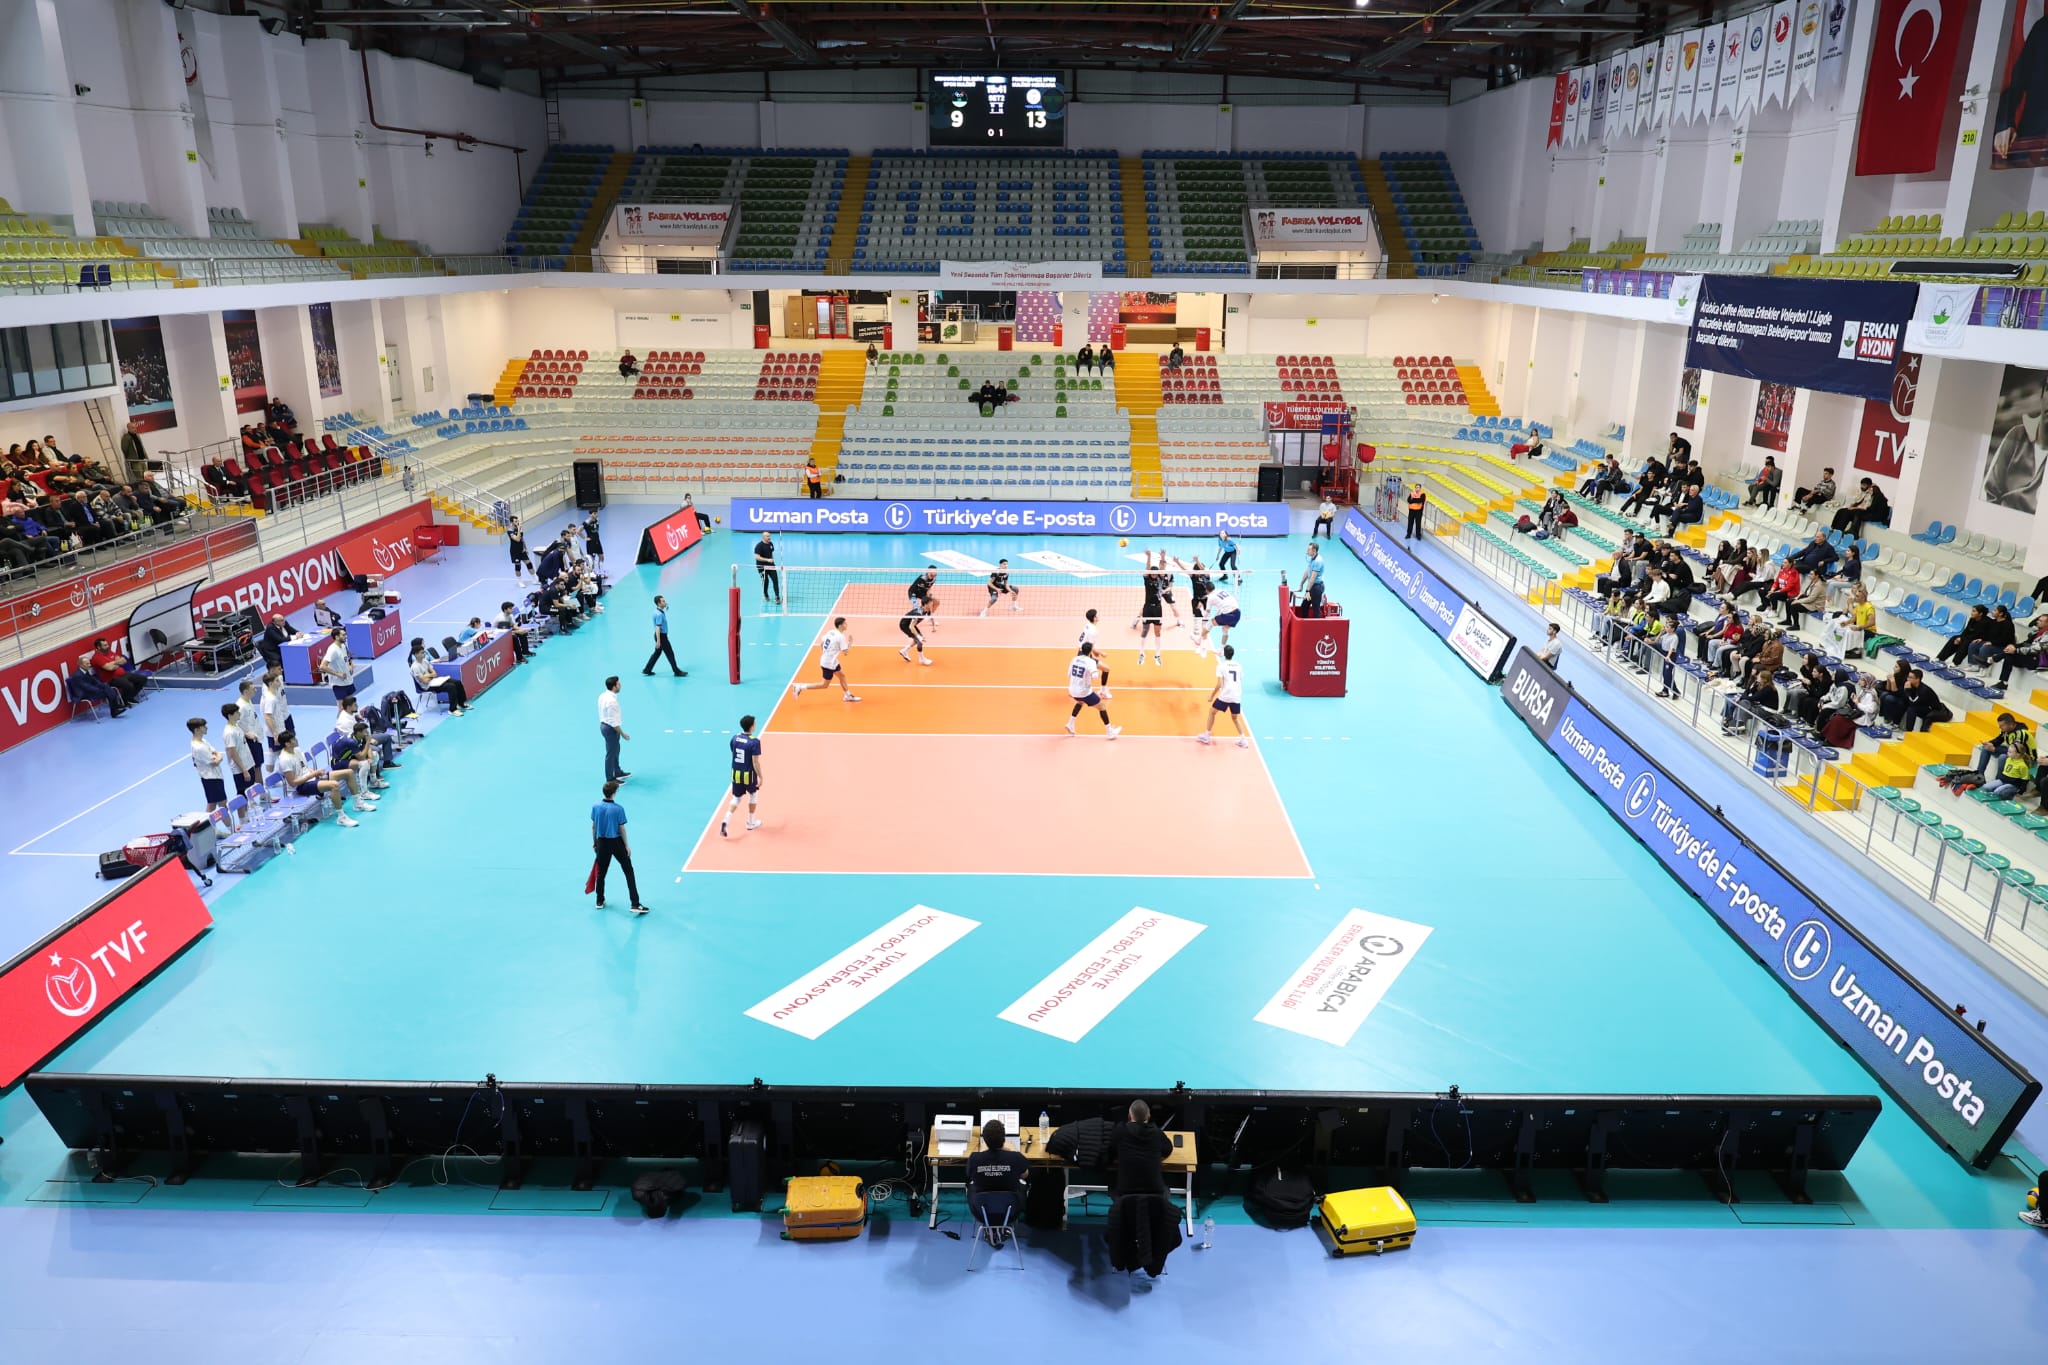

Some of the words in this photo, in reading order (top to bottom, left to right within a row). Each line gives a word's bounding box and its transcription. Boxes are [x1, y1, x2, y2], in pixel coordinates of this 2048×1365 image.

[950, 110, 964, 128] 9
[1026, 111, 1047, 128] 13
[987, 128, 995, 137] 0
[998, 128, 1004, 137] 1
[1962, 134, 1974, 143] 210
[683, 212, 728, 221] VOLEYBOL
[1317, 216, 1362, 225] VOLEYBOL
[1720, 304, 1737, 316] Coffee
[1737, 305, 1755, 318] House
[1780, 308, 1807, 324] Voleybol
[1736, 321, 1767, 337] Osmangazi
[1862, 322, 1899, 340] ERKAN
[1859, 339, 1894, 357] AYDIN
[749, 508, 812, 524] Uzman
[817, 509, 868, 525] Posta
[923, 509, 1018, 528] Türkiye'de
[1023, 510, 1096, 528] E-posta
[1148, 511, 1211, 528] Uzman
[1215, 512, 1268, 528] Posta
[676, 524, 689, 542] TVF
[389, 537, 412, 560] TVF
[1391, 561, 1411, 586] E-posta
[1419, 585, 1439, 613] Uzman
[1437, 601, 1455, 626] Posta
[385, 624, 397, 640] TVF
[1472, 627, 1493, 648] ARABICA
[487, 651, 502, 673] TVF
[1229, 670, 1237, 682] 7
[1512, 668, 1556, 726] BURSA
[735, 748, 745, 764] 3
[1560, 716, 1595, 760] Uzman
[1592, 746, 1626, 790] Posta
[1650, 799, 1720, 877] Türkiye'de
[1715, 862, 1787, 940] E-posta
[872, 915, 938, 952] VOLEYBOL
[1106, 917, 1162, 954] VOLEYBOL
[1330, 924, 1363, 956] ERKEKLER
[91, 919, 149, 978] TVF
[847, 951, 907, 988] TÜRKİYE
[1092, 954, 1142, 990] TÜRKİYE
[1305, 956, 1336, 988] VOLEYBOL
[773, 953, 875, 1020] FEDERASYONU
[1027, 956, 1112, 1023] FEDERASYONU
[1317, 956, 1376, 1013] ARABICA
[1829, 965, 1909, 1055] Uzman
[1906, 1036, 1986, 1126] Posta
